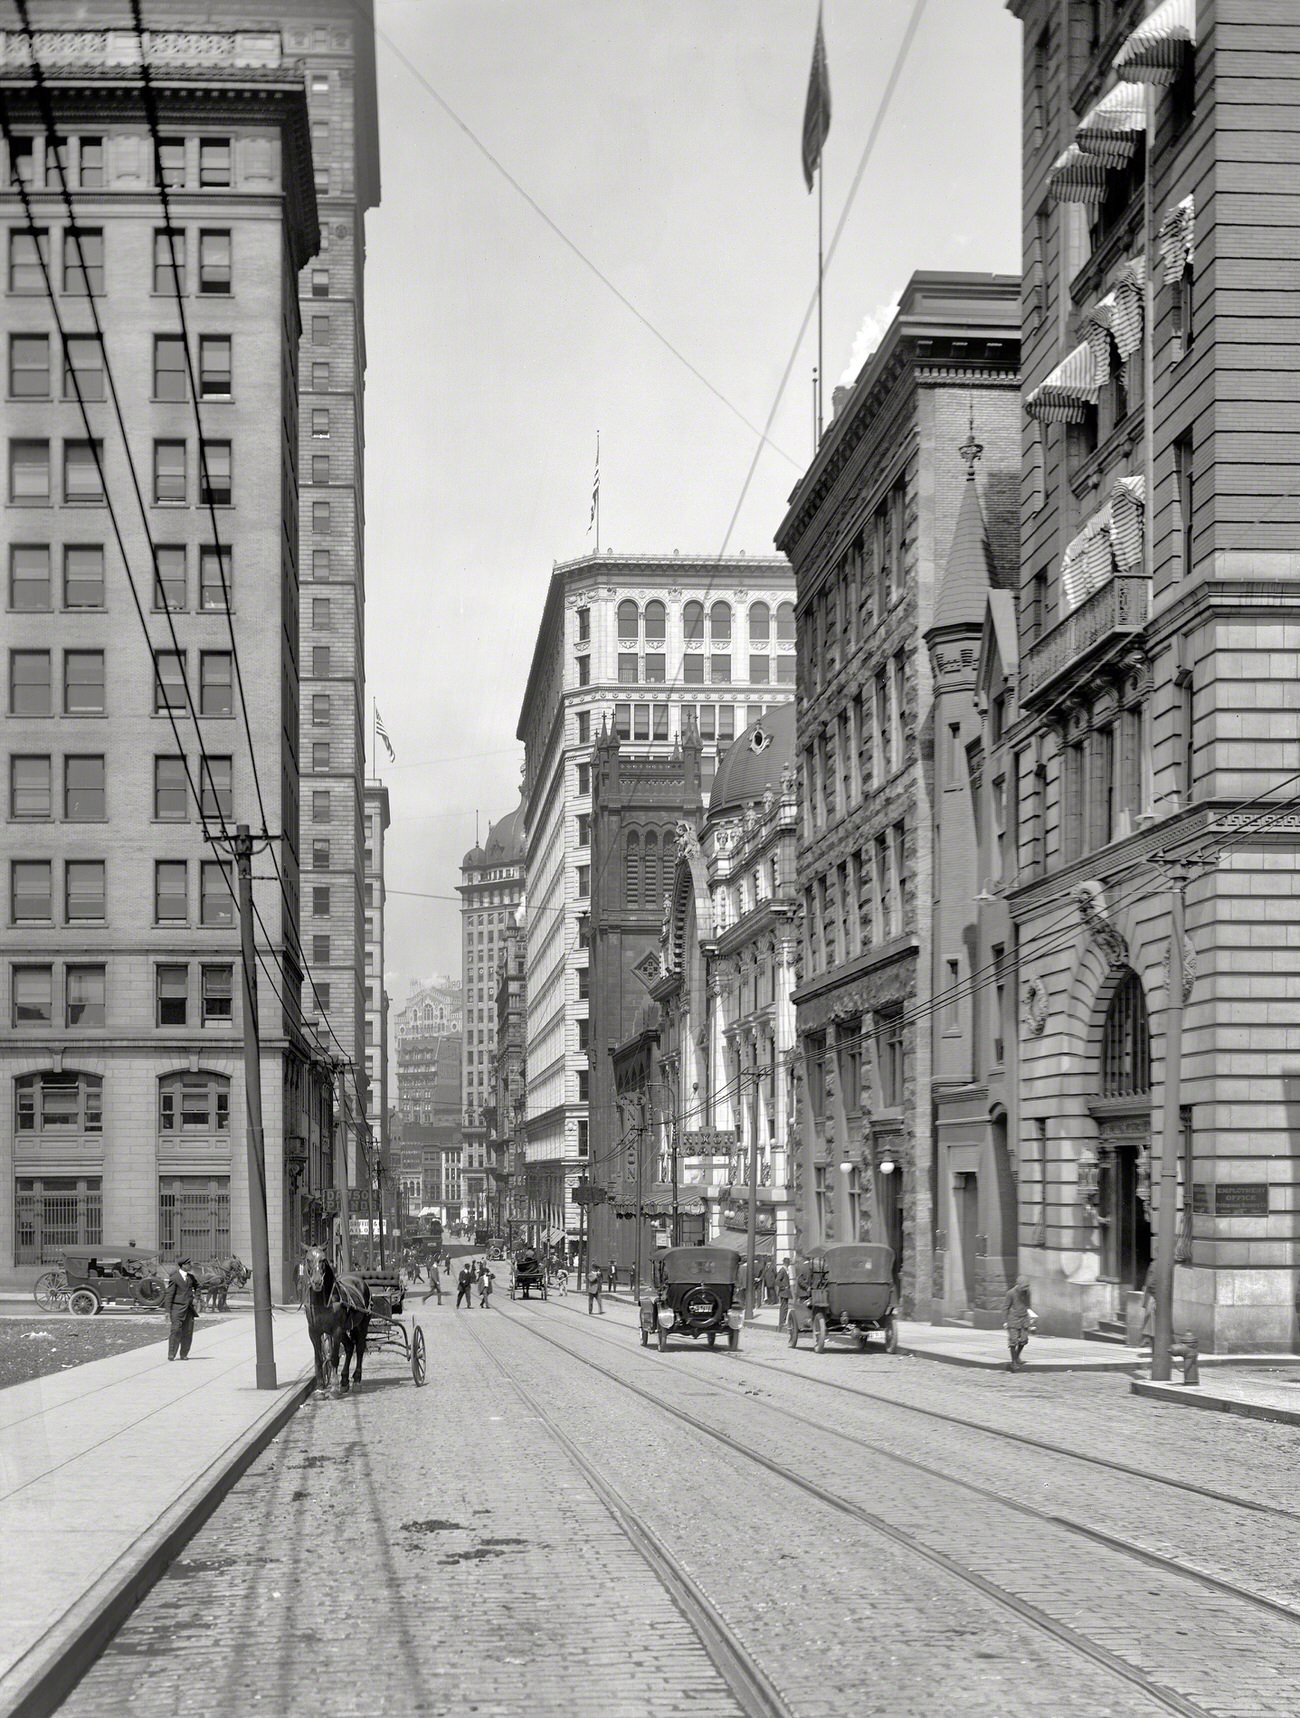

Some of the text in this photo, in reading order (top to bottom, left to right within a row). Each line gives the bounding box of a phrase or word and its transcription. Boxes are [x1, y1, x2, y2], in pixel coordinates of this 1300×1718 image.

[683, 1133, 734, 1145] NIXON
[685, 1145, 732, 1156] CAFE
[326, 1201, 378, 1210] PINOS
